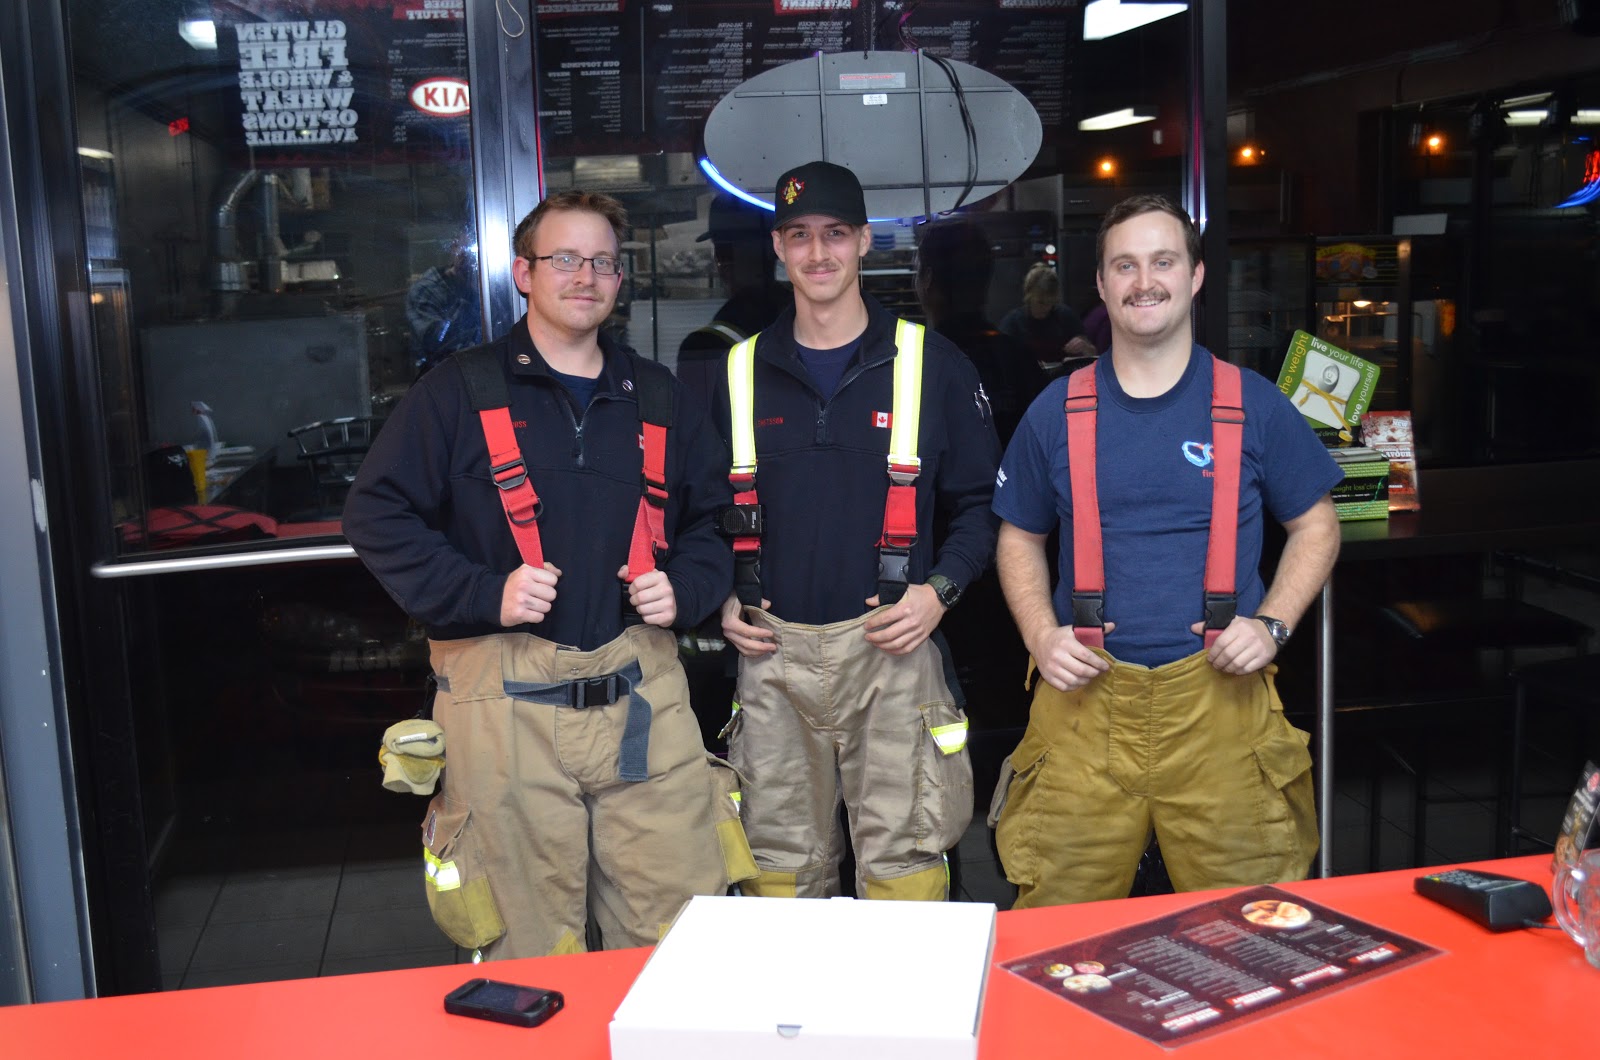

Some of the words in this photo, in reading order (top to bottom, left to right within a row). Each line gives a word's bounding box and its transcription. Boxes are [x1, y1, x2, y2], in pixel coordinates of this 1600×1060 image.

[424, 86, 469, 107] KIA
[1288, 334, 1309, 374] weight
[1311, 337, 1328, 352] live
[1328, 347, 1349, 363] your
[1350, 355, 1364, 369] life
[1348, 403, 1362, 425] love
[1359, 365, 1376, 404] yourself
